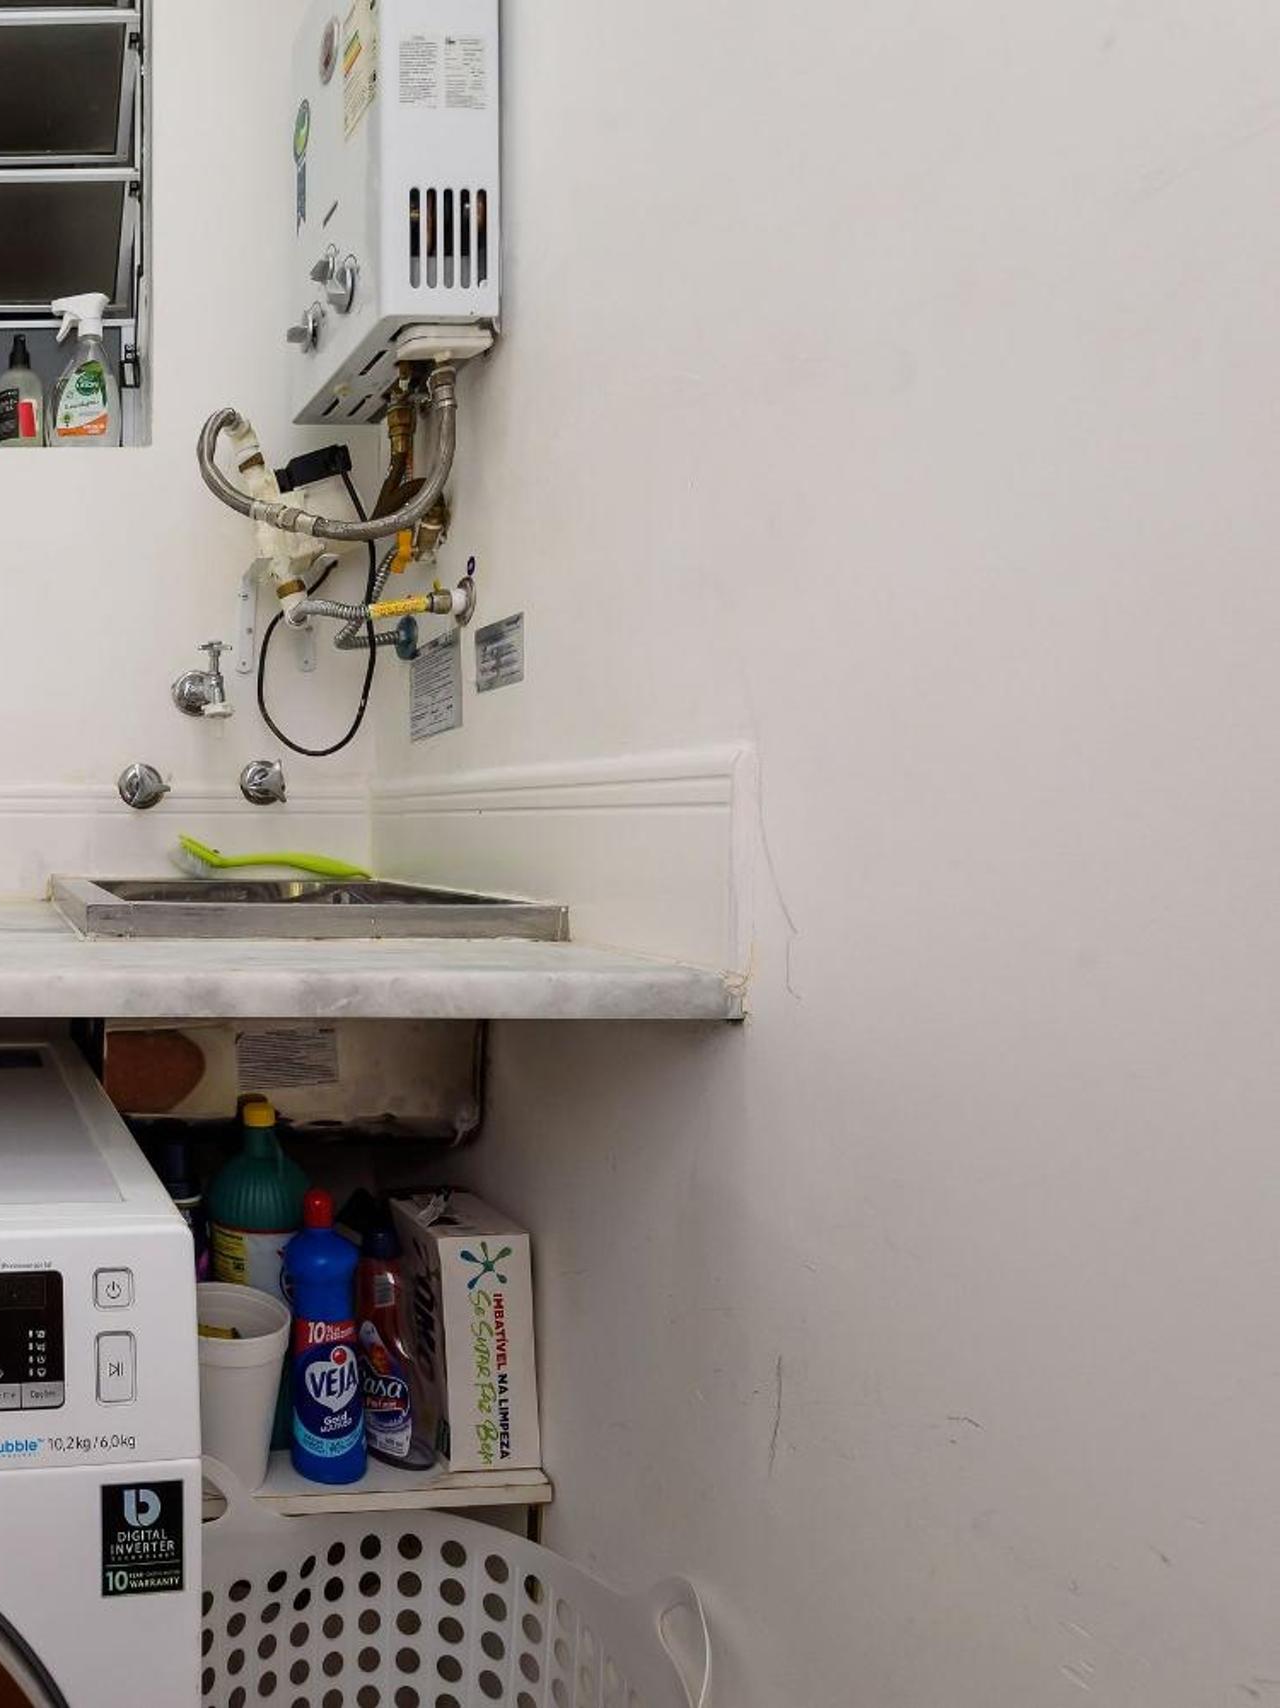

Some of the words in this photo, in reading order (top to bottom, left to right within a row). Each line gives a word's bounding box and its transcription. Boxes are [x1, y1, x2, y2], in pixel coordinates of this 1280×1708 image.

[492, 1293, 509, 1371] IMBATÍVEL
[309, 1362, 358, 1400] VEJA
[498, 1373, 509, 1396] NA
[498, 1398, 511, 1460] LIMPEZA
[116, 1528, 168, 1543] DIGITAL
[110, 1540, 176, 1555] INVERTER
[105, 1570, 129, 1592] 10
[129, 1576, 181, 1589] WARRANTY
